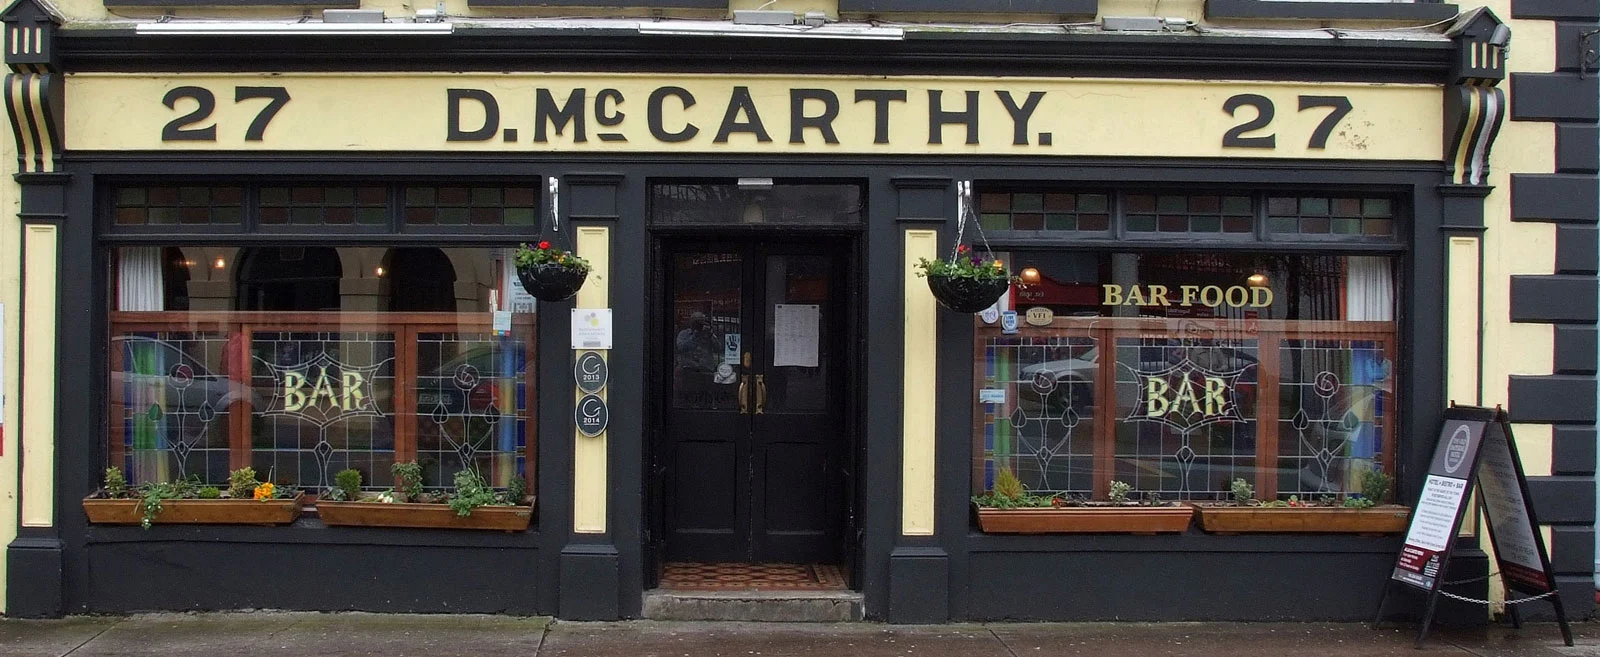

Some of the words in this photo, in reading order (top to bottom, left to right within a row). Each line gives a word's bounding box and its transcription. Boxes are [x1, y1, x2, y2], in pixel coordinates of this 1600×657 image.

[161, 85, 291, 142] 27
[1222, 93, 1354, 150] 27
[1102, 284, 1171, 306] BAR
[1180, 285, 1274, 307] FOOD
[284, 367, 367, 412] BAR
[1147, 371, 1229, 417] BAR
